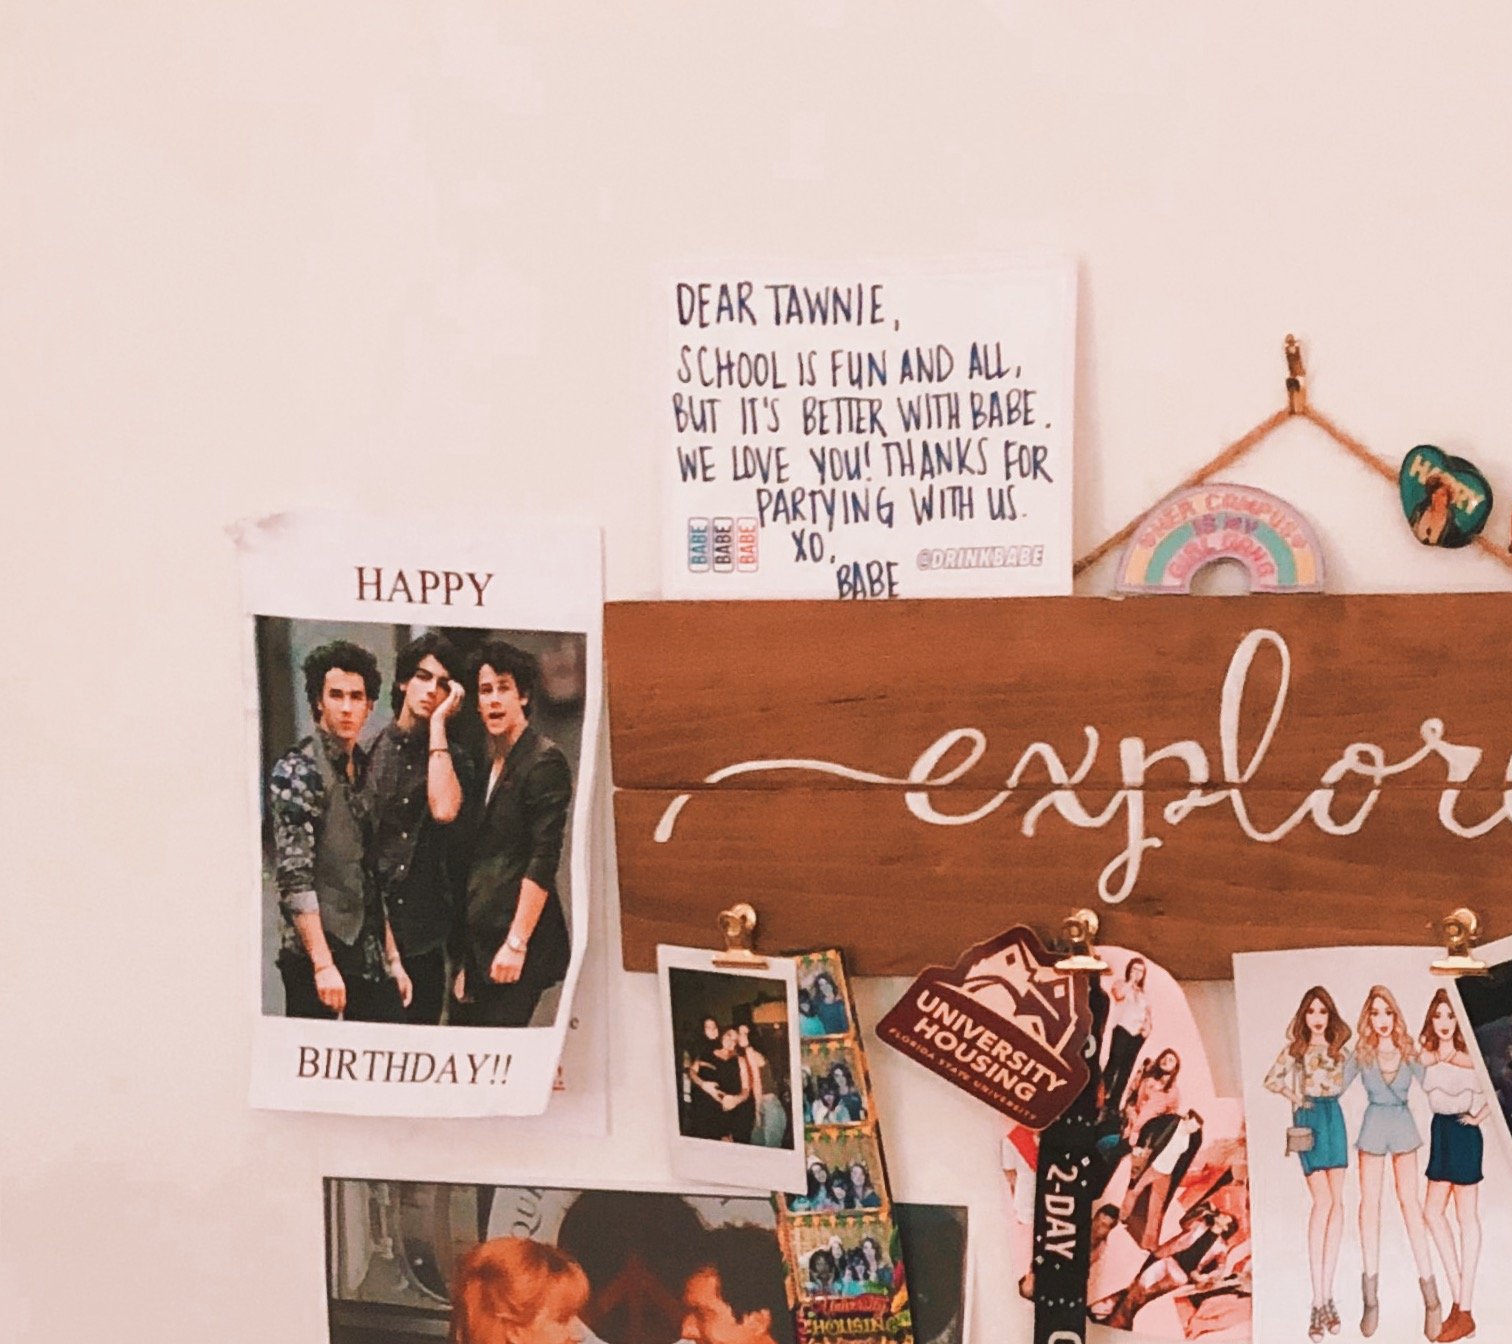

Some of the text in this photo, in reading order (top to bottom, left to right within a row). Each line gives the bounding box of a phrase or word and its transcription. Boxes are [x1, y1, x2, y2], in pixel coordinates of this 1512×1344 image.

[677, 281, 900, 331] DEAR TAWNIE,
[677, 342, 1021, 390] SCHOOL IS FUN AND ALL,
[673, 388, 1051, 437] BUT IT'S BETTER WITH BABE.
[678, 437, 1054, 484] WE LOVE YOU! THANKS FOR
[757, 484, 1027, 532] PARTYING WITH US.
[690, 524, 708, 565] BABE
[715, 522, 733, 565] BABE
[739, 523, 756, 565] BABE
[792, 530, 836, 564] XO,
[917, 545, 1044, 571] @DRINKBABE
[354, 566, 495, 607] HAPPY
[836, 561, 899, 599] BABE
[913, 1017, 1037, 1101] HOUSING
[916, 989, 1067, 1092] UNIVERSITY
[297, 1046, 512, 1085] BIRTHDAY!!
[887, 1027, 1038, 1120] FLORIDA STATE UNIVERSITY
[1045, 1164, 1078, 1260] 2-DAY
